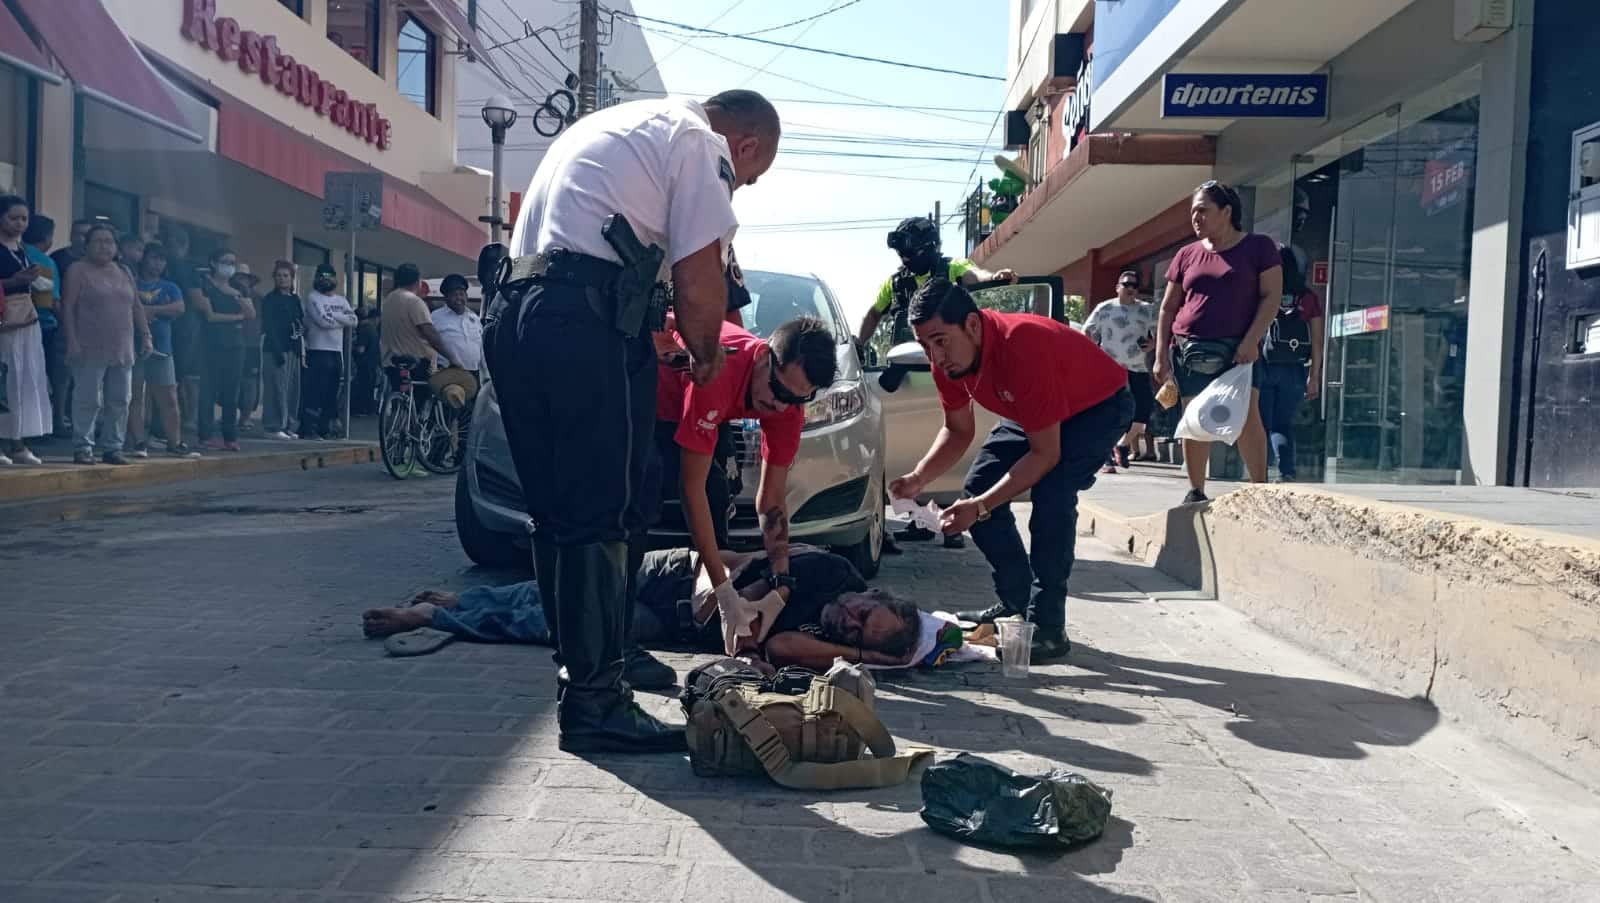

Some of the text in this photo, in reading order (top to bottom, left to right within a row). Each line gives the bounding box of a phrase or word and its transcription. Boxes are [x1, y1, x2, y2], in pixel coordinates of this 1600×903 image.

[181, 0, 392, 151] Restaurante
[1062, 59, 1093, 160] Seño
[1170, 83, 1318, 107] dportenis
